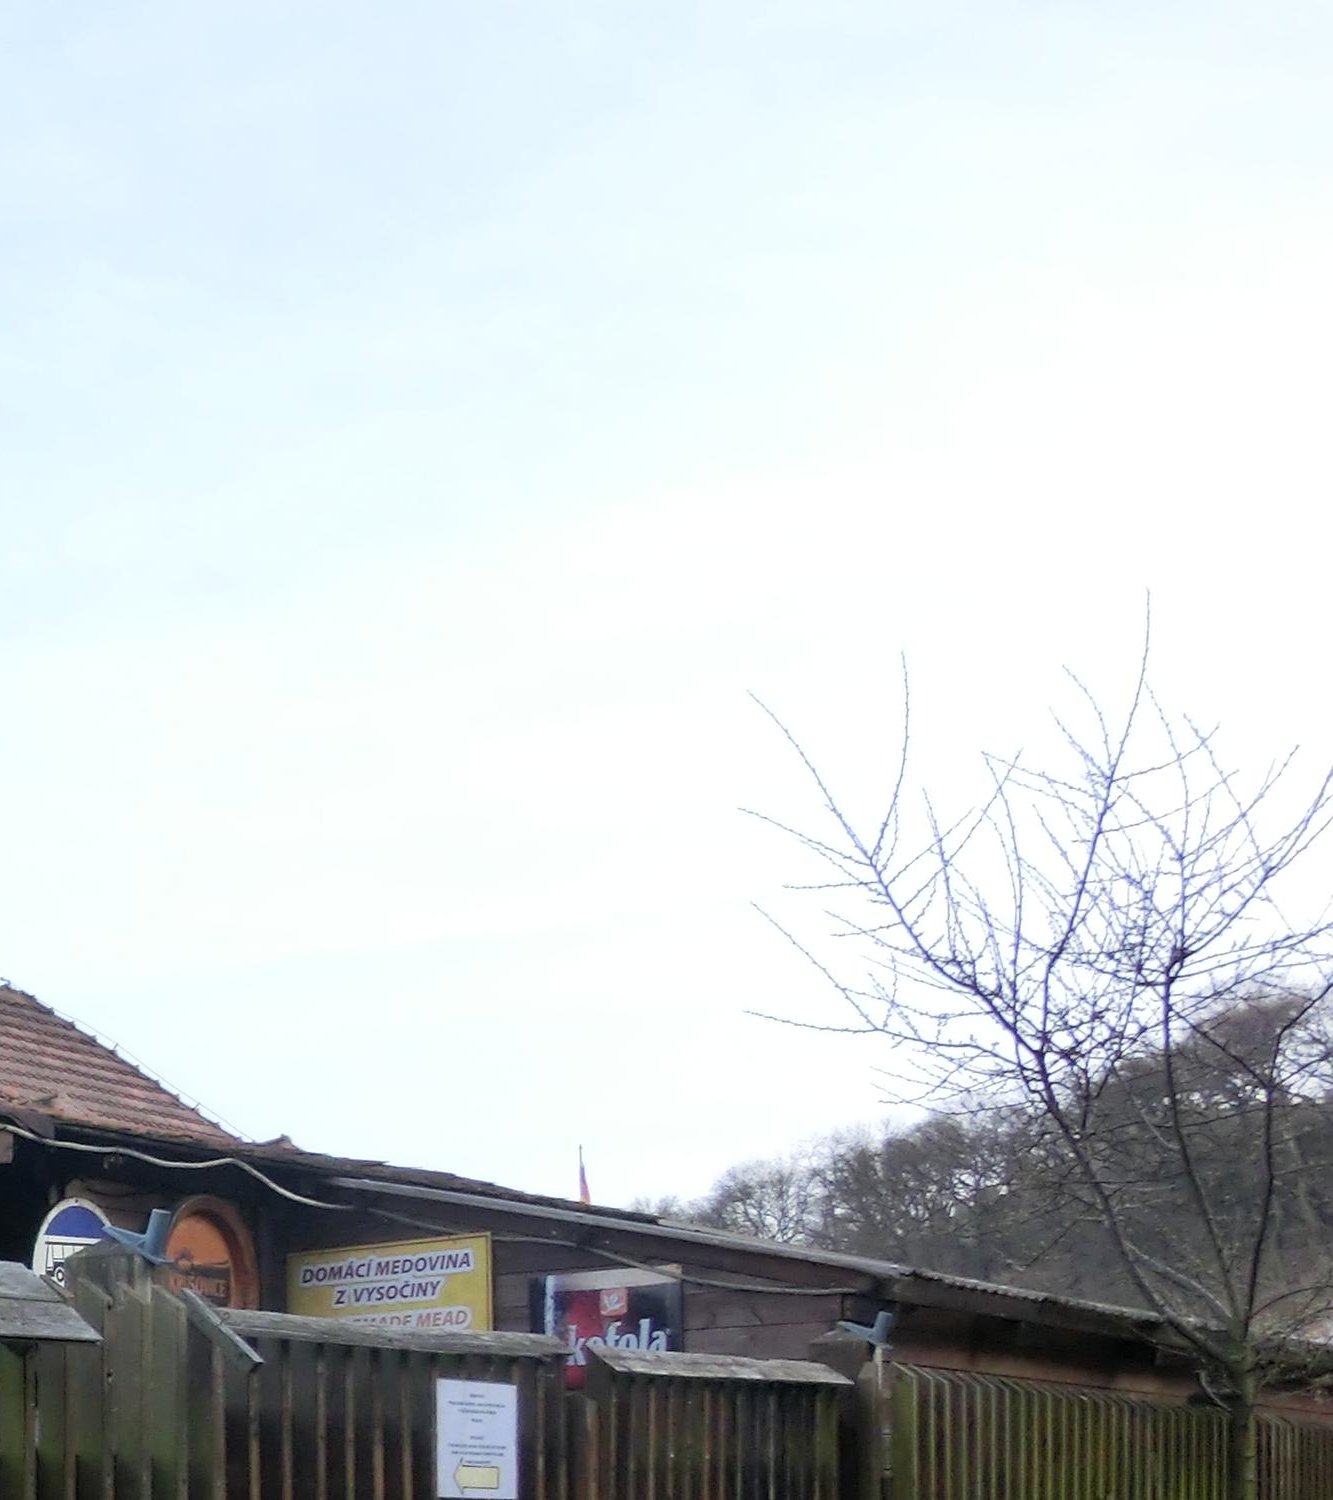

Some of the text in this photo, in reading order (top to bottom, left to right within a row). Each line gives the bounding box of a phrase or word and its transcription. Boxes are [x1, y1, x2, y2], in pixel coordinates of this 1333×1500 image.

[302, 1252, 471, 1284] DOMÁCÍ MEDOVINA
[334, 1280, 441, 1305] Z VYSOČINY
[416, 1310, 469, 1327] MEAD
